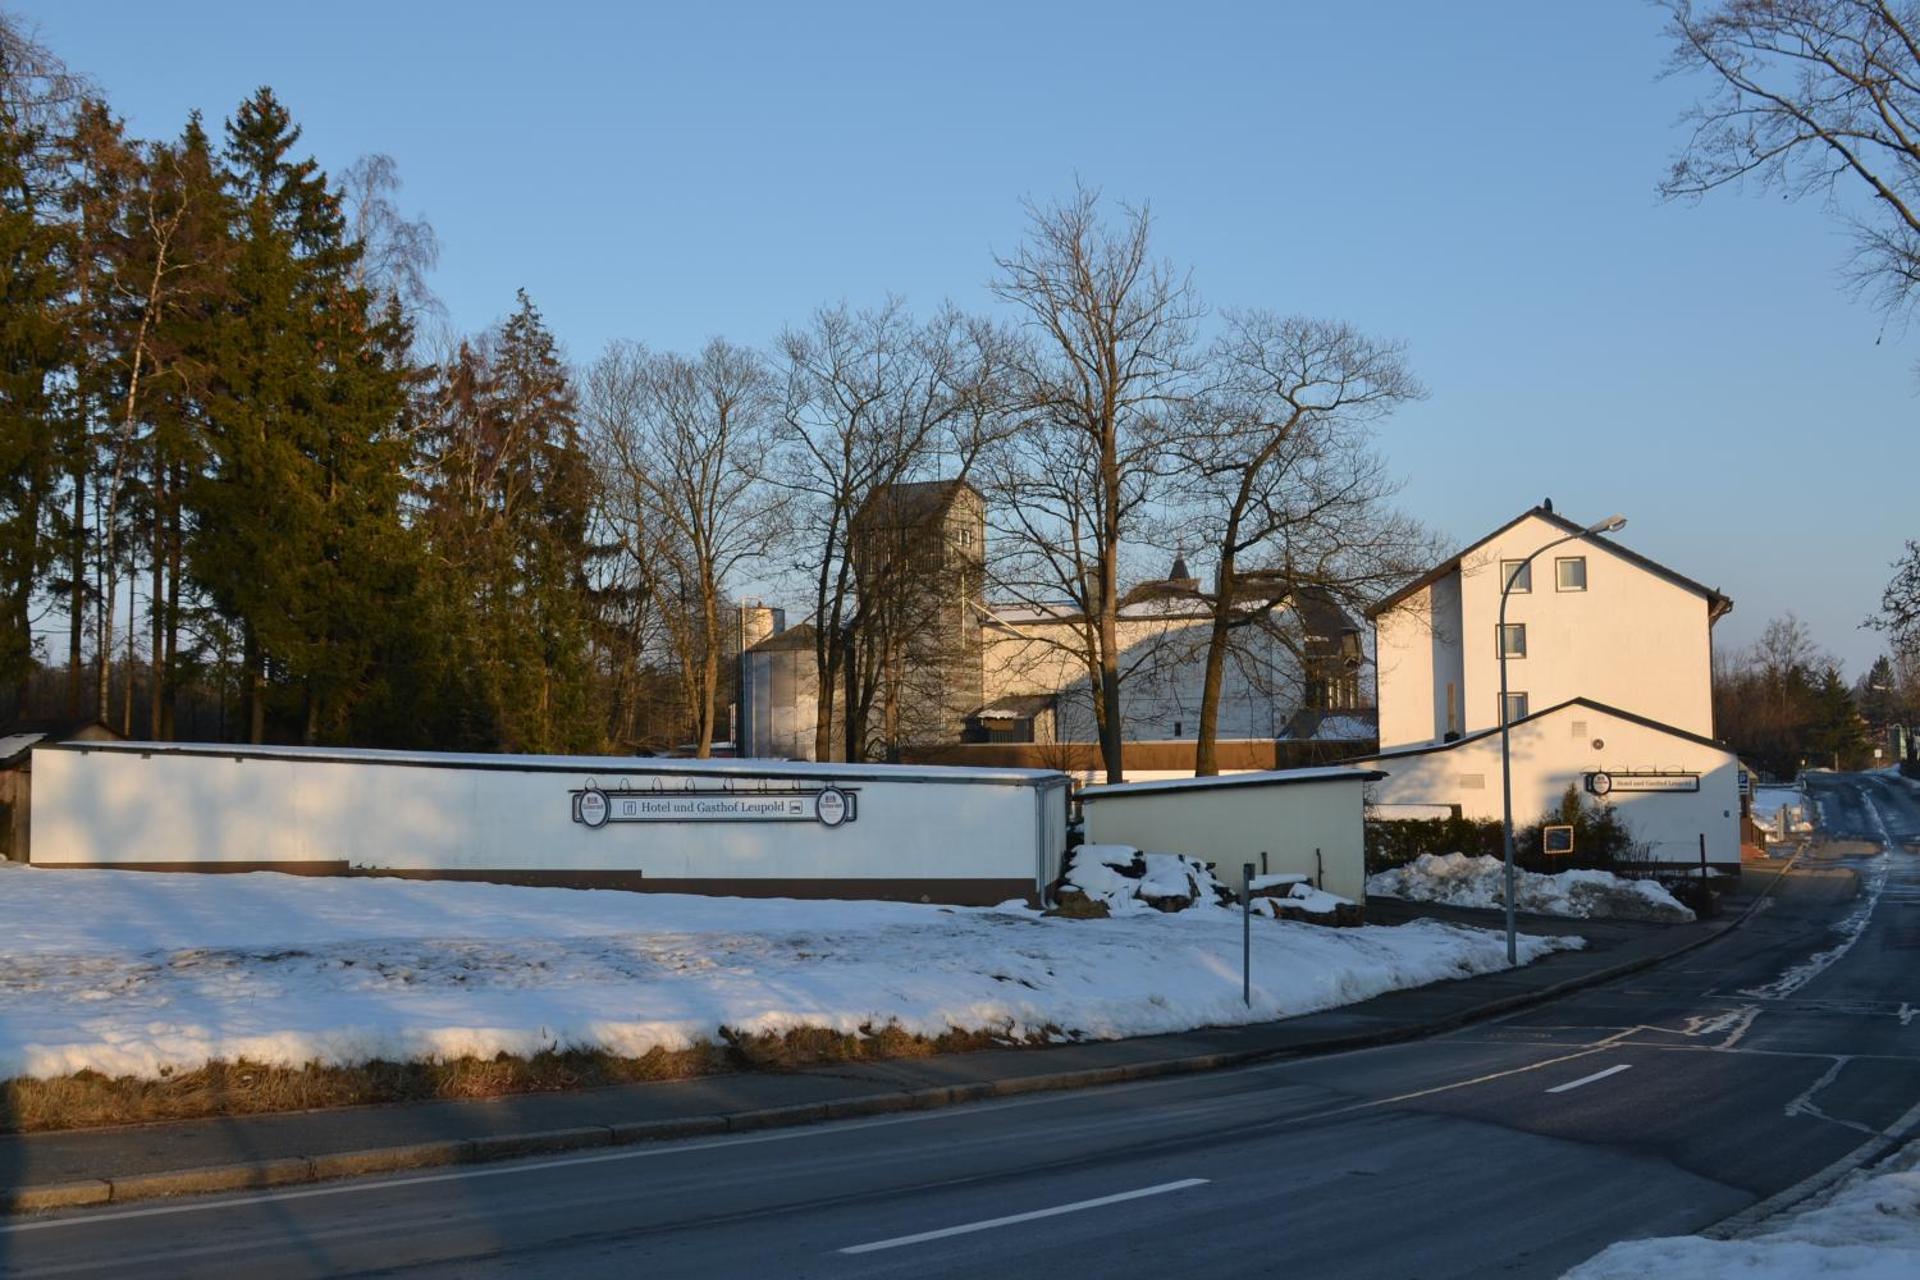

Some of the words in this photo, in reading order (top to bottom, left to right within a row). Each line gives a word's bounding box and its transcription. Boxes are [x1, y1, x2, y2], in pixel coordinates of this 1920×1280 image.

[641, 802, 670, 812] Hotel
[674, 802, 693, 812] und
[697, 801, 739, 812] Gasthof
[742, 801, 785, 814] Leupold
